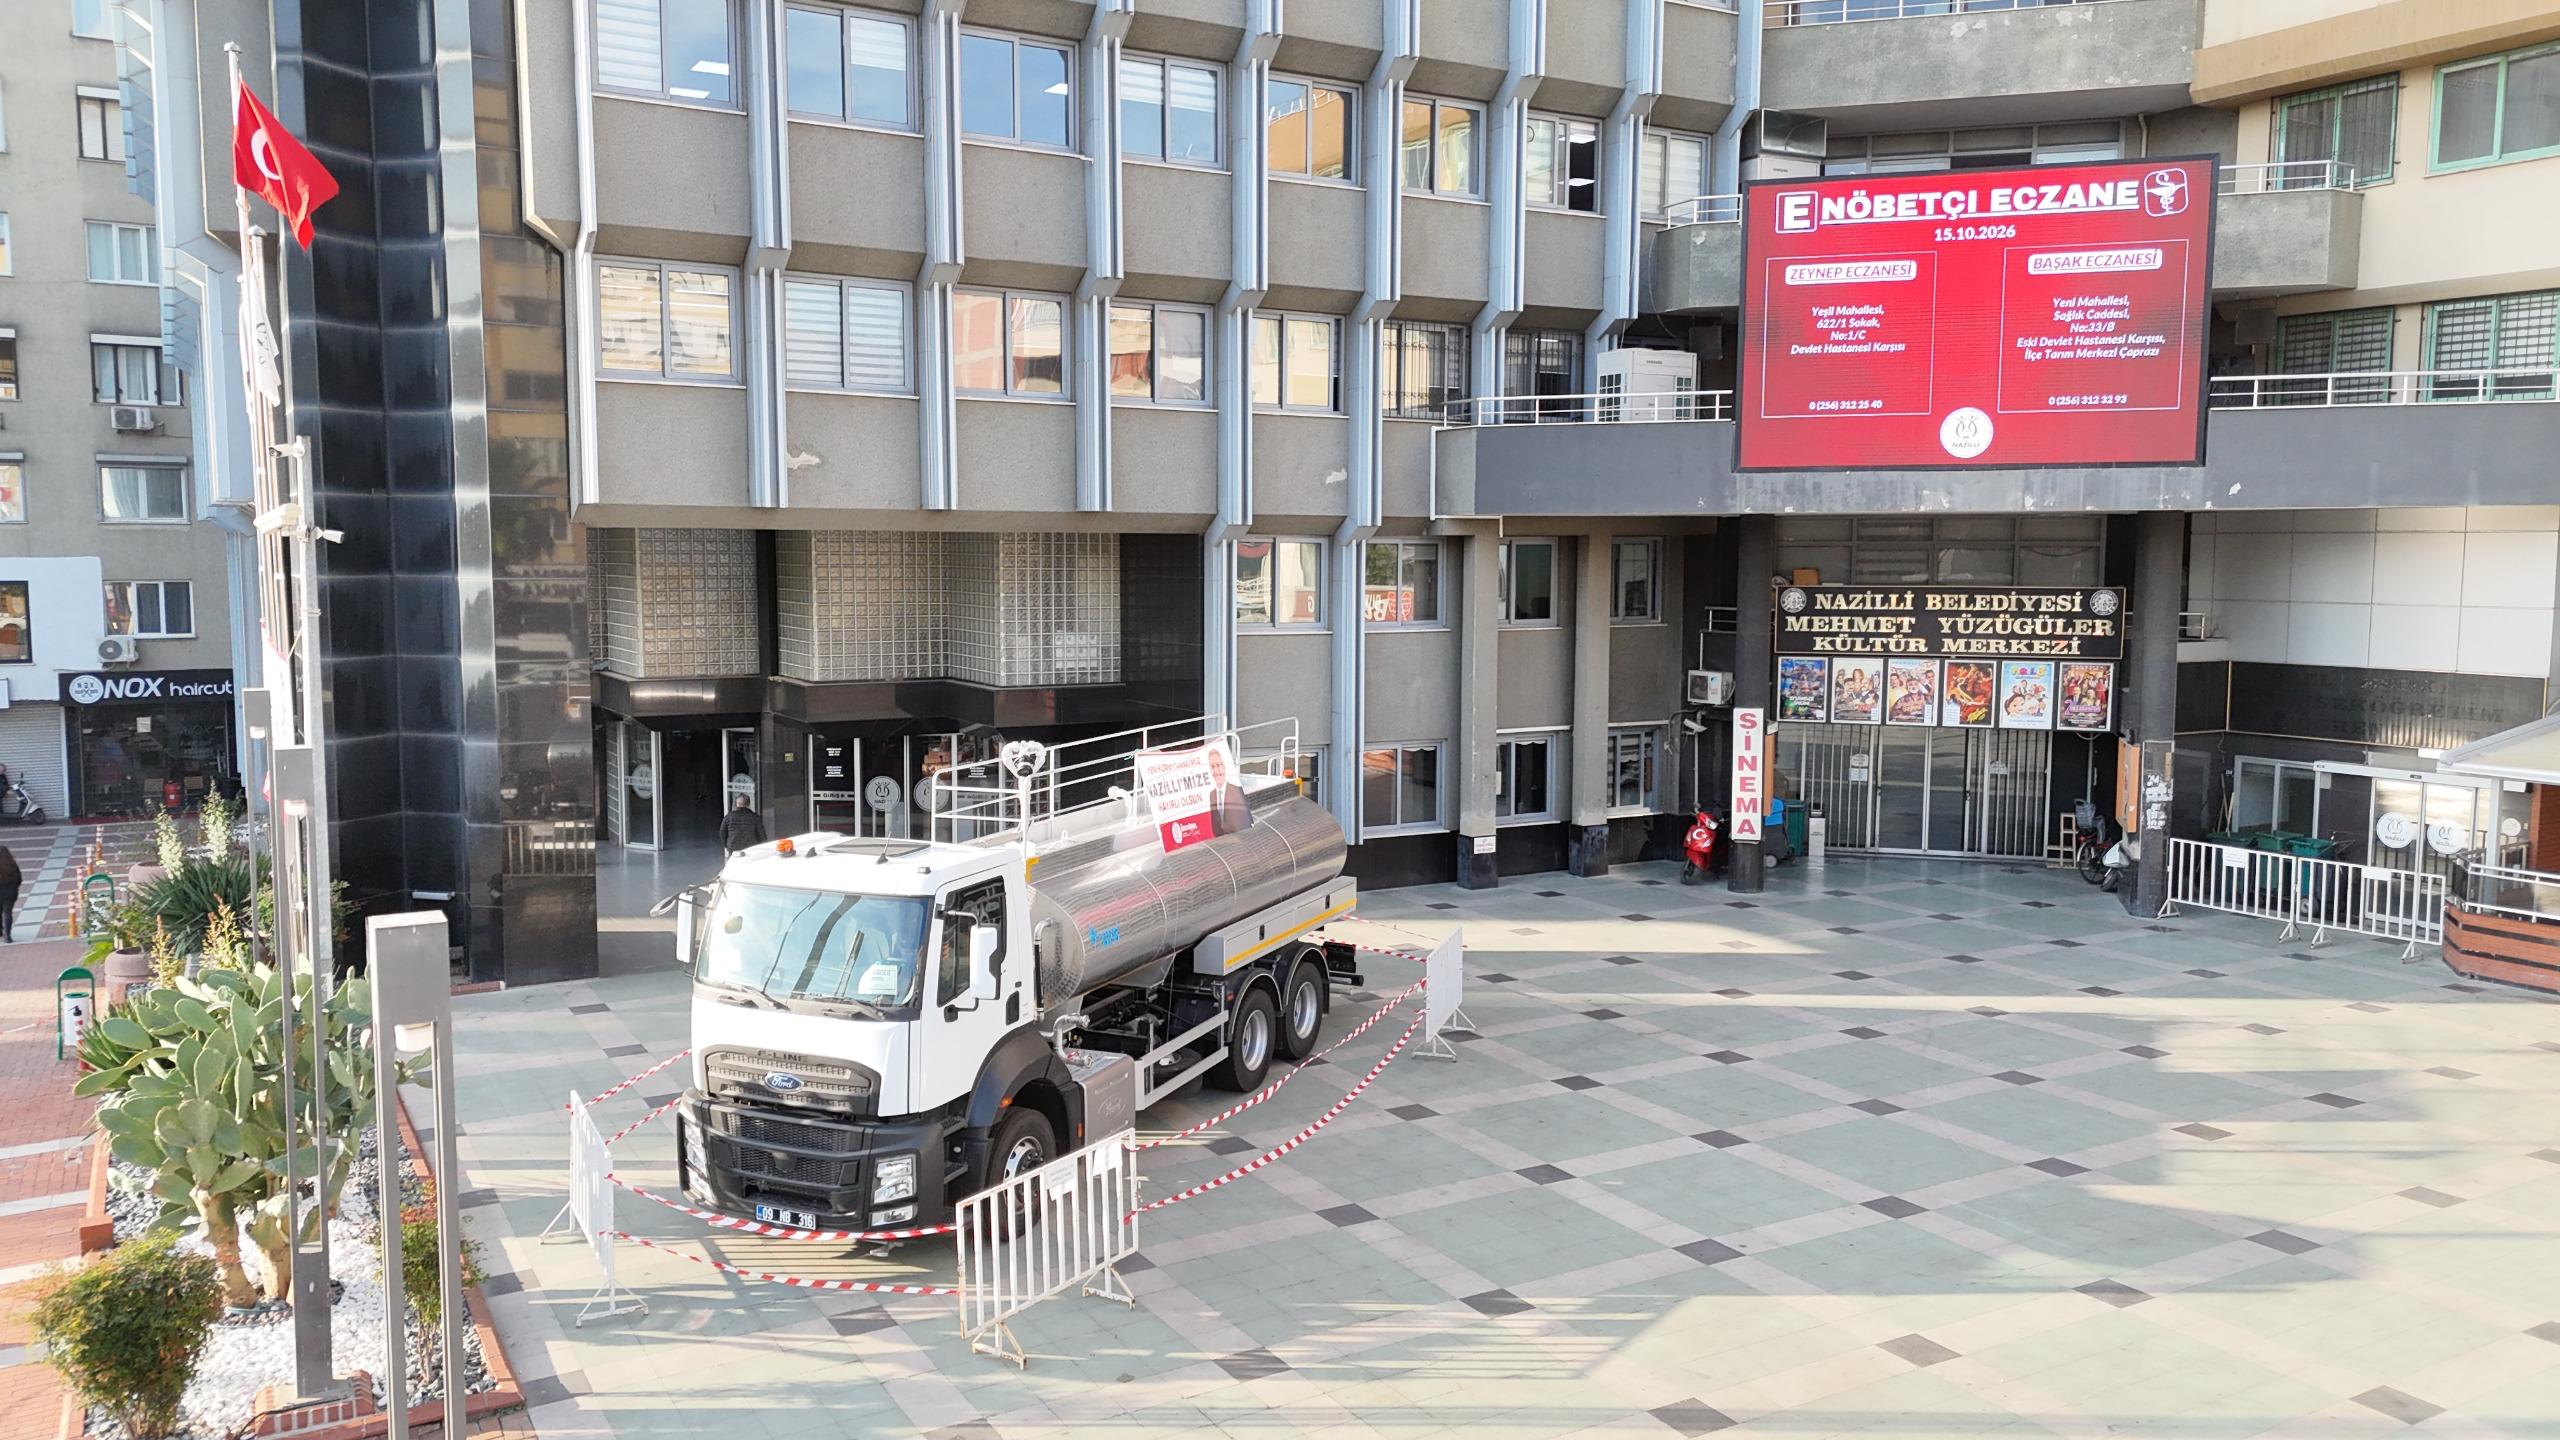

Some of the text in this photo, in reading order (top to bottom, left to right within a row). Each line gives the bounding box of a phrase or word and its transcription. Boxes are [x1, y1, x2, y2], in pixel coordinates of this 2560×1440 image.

[1783, 195, 1811, 229] E
[1990, 180, 2140, 213] ECZANE
[1934, 225, 2016, 242] 15.10.2026
[2033, 250, 2158, 271] BAŞAK ECZANESİ
[1790, 261, 1912, 280] ZEYNEP ECZANESİ
[2053, 295, 2131, 308] Yeni Mahallesi,
[1811, 304, 1885, 318] Yeşil Mahallesi,
[2053, 308, 2131, 322] Sağlık Caddesi,
[1816, 318, 1881, 329] 622/1 Sokak,
[2069, 322, 2116, 333] No:33/B
[1830, 330, 1867, 341] No:1/C
[2016, 333, 2166, 348] Eski Devlet Hastanesi Karşısı,
[1790, 342, 1906, 355] Devlet Hastanesi Karşısı
[2024, 347, 2160, 362] İlçe Tarım Merkezi Çaprazı
[1816, 400, 1839, 411] (256)
[1840, 400, 1856, 410] 312
[1856, 400, 1870, 410] 25
[1870, 400, 1883, 409] 40
[2057, 396, 2080, 406] (256)
[2082, 396, 2099, 405] 312
[2100, 395, 2113, 404] 32
[2115, 395, 2127, 404] 93
[1815, 591, 2083, 613] NAZİLLİ BELEDİYESİ
[1785, 613, 2116, 637] MEHMET YÜZÜGÜLER
[1813, 634, 2082, 655] KÜLTÜR MERKEZİ
[103, 677, 233, 699] NOX haircut
[1736, 712, 1758, 835] SİNEMA
[762, 1208, 774, 1221] 09
[798, 1213, 813, 1228] 316
